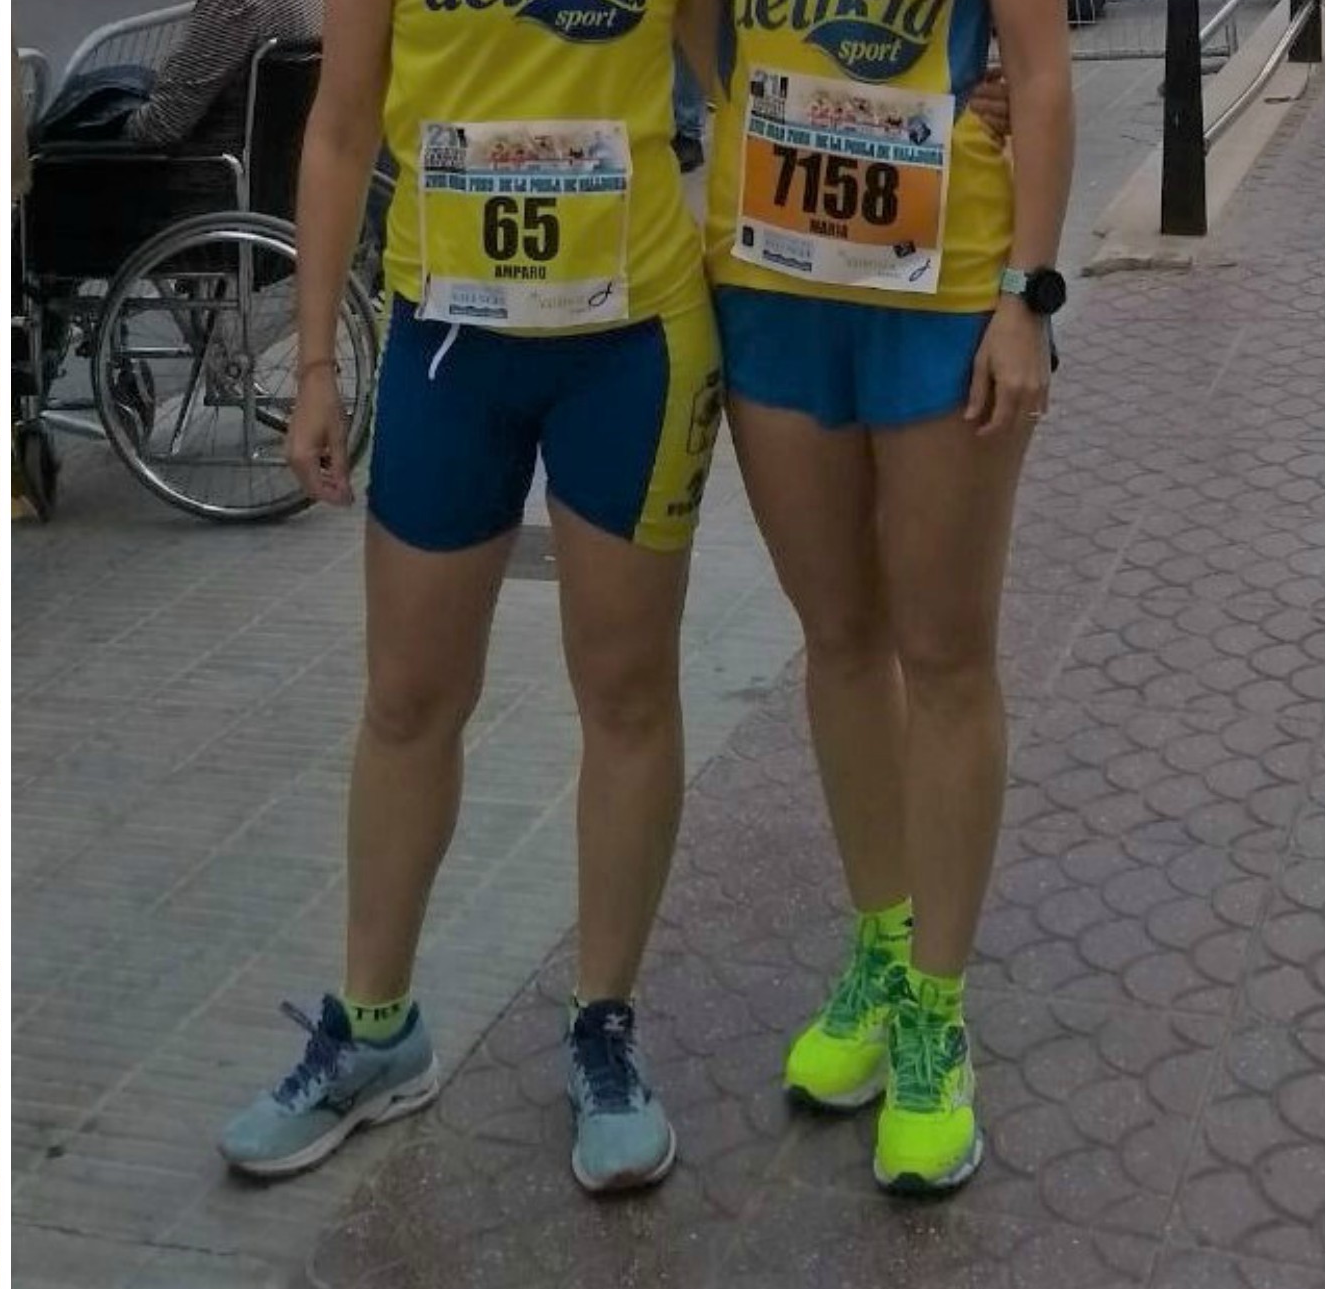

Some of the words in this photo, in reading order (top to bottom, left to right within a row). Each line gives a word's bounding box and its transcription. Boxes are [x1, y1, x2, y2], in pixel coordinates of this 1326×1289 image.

[554, 7, 618, 31] sport
[838, 38, 902, 63] sport
[773, 143, 900, 226] 7158
[483, 195, 560, 262] 65
[494, 265, 546, 280] AMPARO
